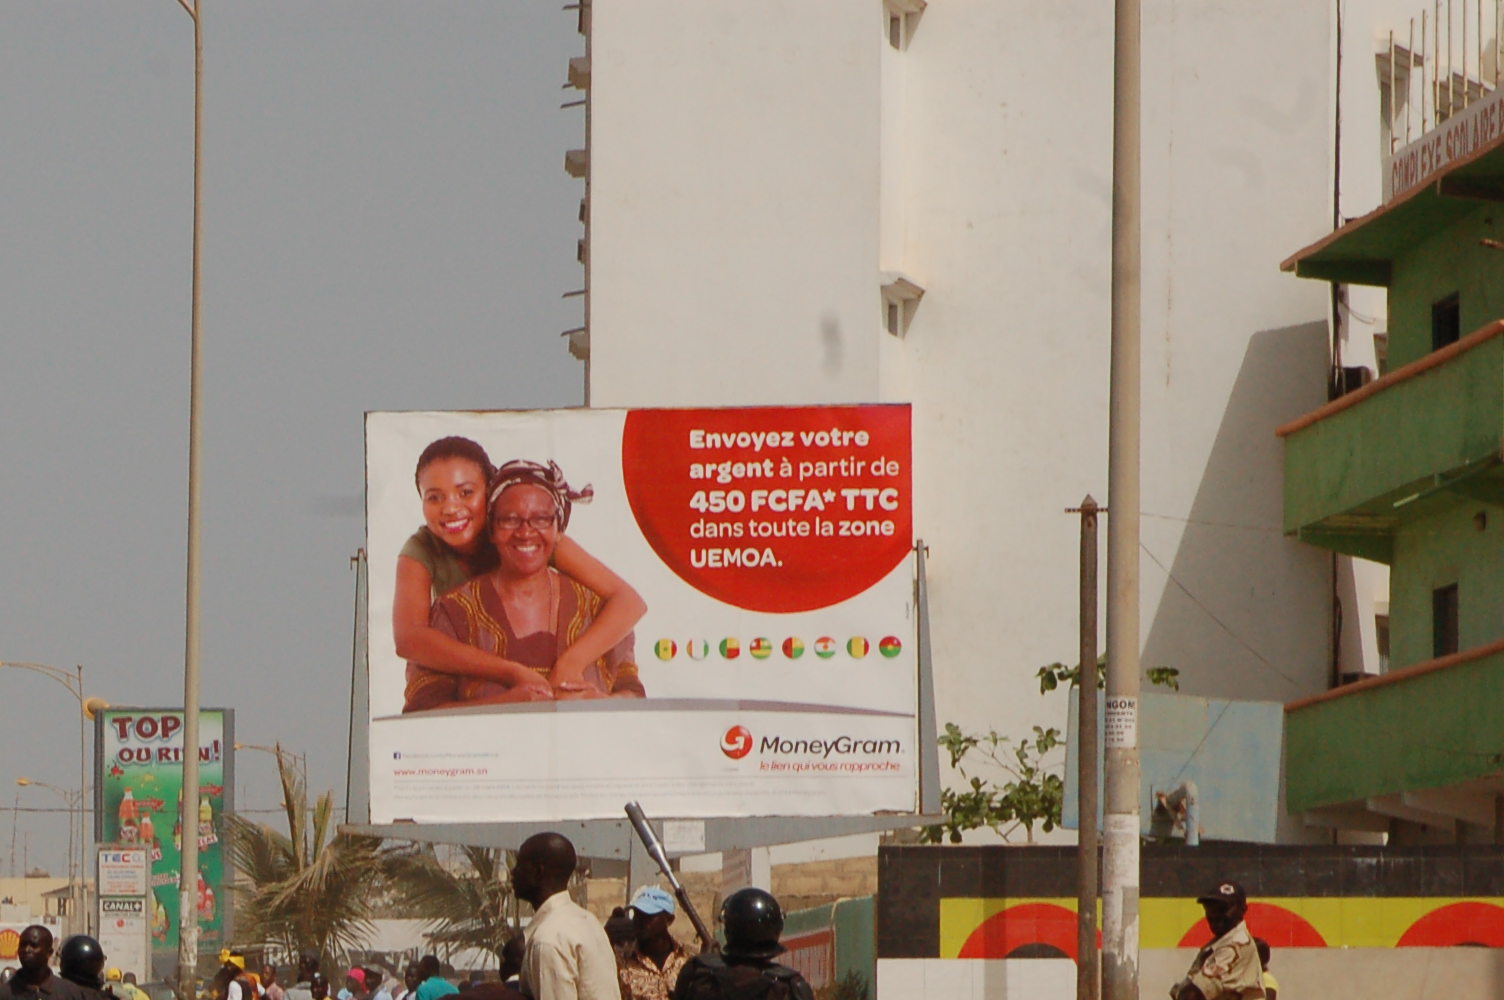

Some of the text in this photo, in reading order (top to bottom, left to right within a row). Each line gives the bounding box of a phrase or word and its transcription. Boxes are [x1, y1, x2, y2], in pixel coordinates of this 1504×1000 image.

[1392, 135, 1441, 198] COMPLEXE
[1447, 103, 1495, 161] SCOLAIRE
[690, 428, 869, 452] Envoyez votre
[689, 456, 899, 483] argent à partir de
[689, 490, 745, 512] 450
[841, 488, 898, 511] TTC
[690, 516, 894, 538] dans toute la zone
[691, 548, 783, 567] UEMOA.
[112, 716, 181, 739] TOP
[119, 740, 219, 762] OU RIN!
[760, 736, 901, 759] MoneyGram
[771, 761, 791, 771] lien
[792, 761, 810, 773] qui
[811, 763, 838, 771] vous
[840, 761, 900, 773] rapproche
